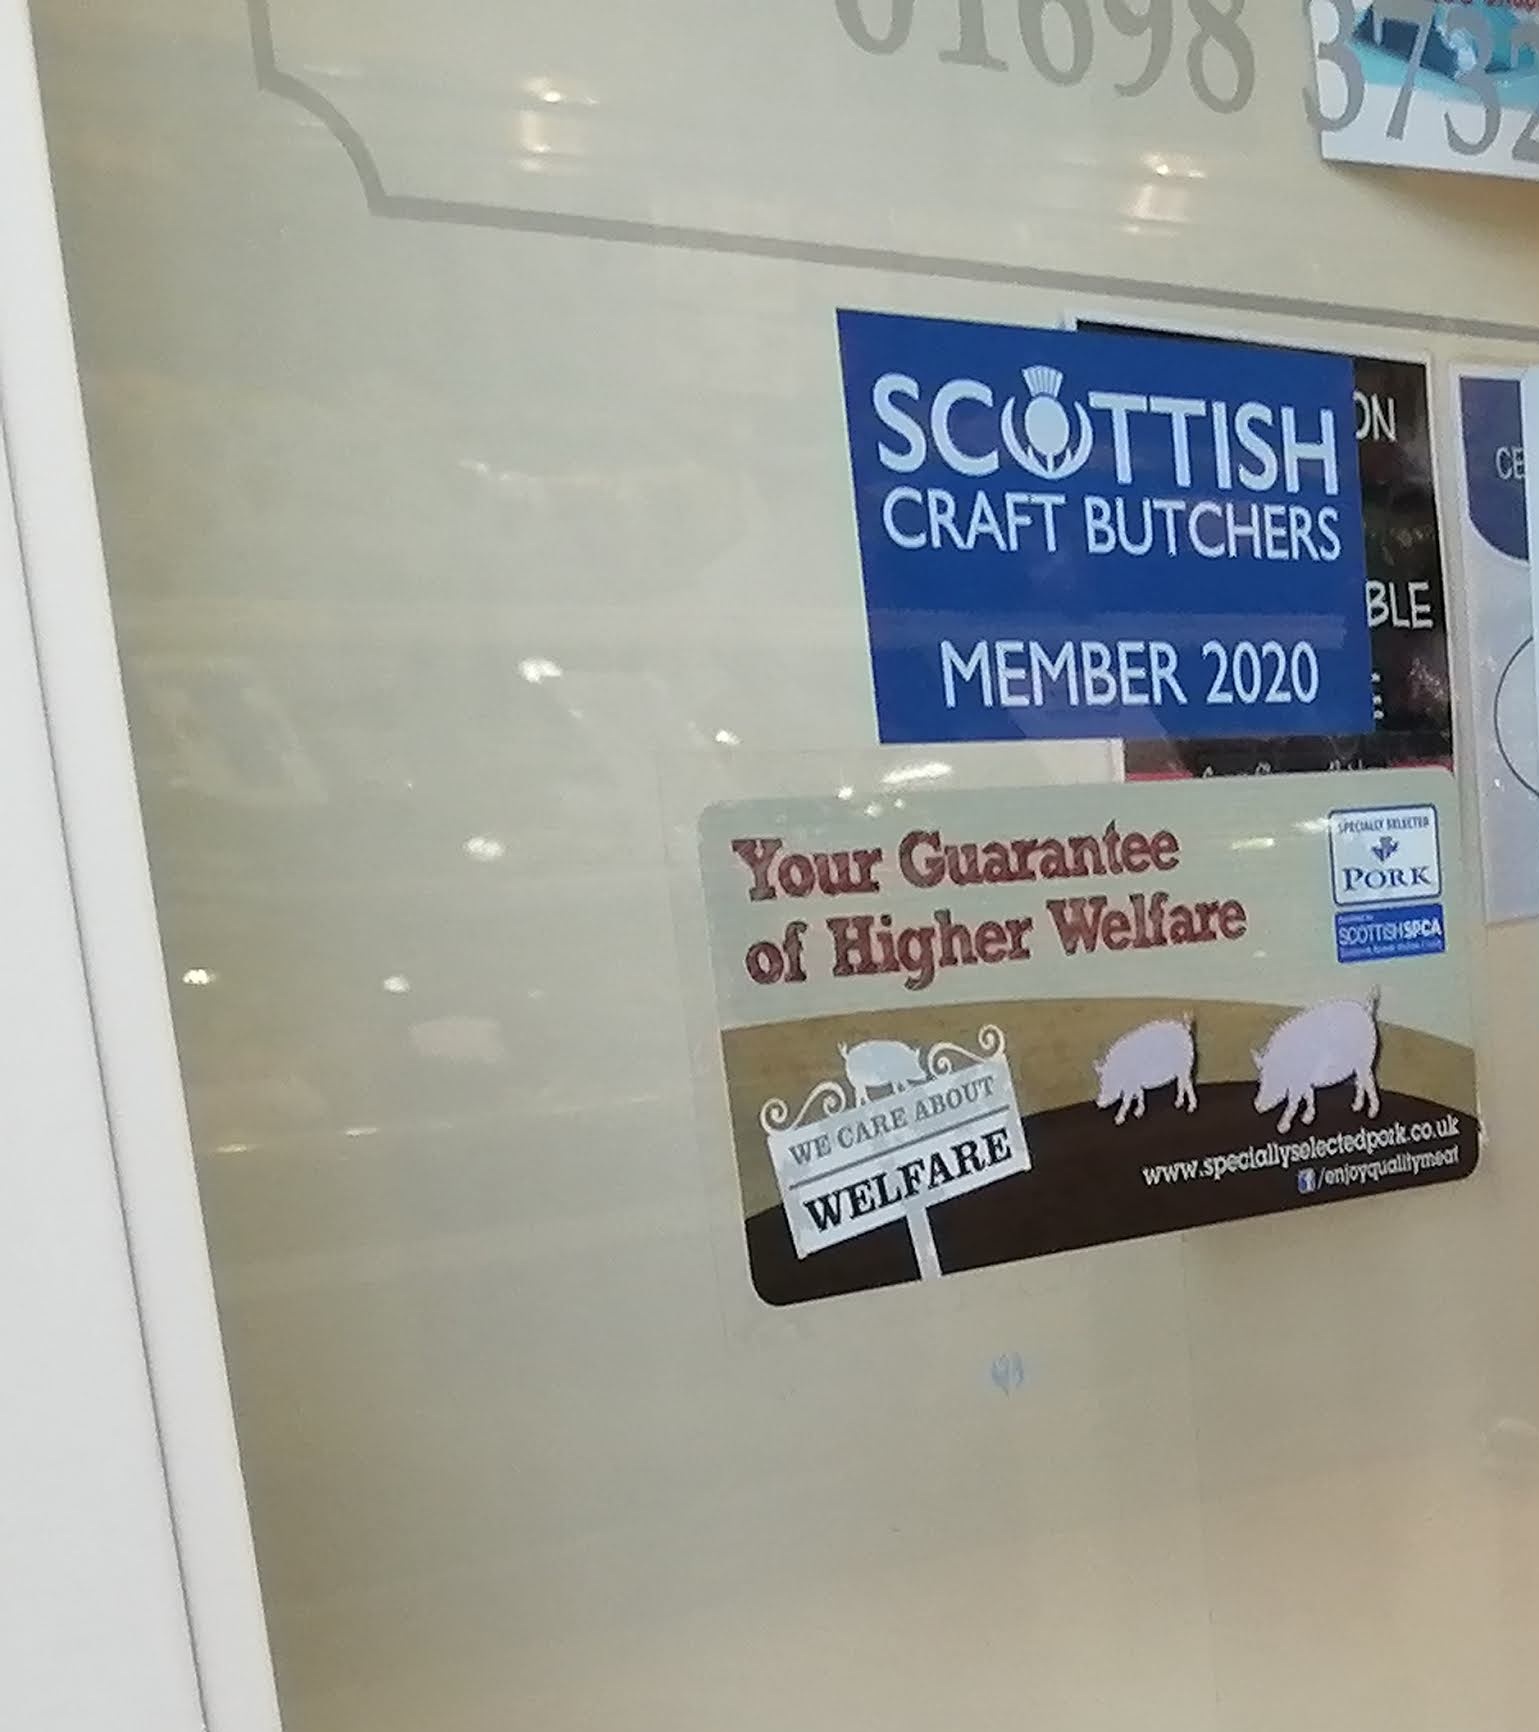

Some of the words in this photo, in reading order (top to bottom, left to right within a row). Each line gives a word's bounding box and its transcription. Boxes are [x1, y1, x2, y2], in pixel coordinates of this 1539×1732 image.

[872, 366, 1339, 495] SCOTTISH
[882, 487, 1066, 552] CRAFT
[1085, 496, 1342, 562] BUTCHERS
[1365, 579, 1434, 630] BLE
[940, 640, 1188, 708] MEMBER
[1200, 641, 1320, 704] 2020
[732, 838, 881, 901] Your
[898, 820, 1180, 888] Guarantee
[1342, 865, 1431, 891] PORK
[744, 921, 806, 985] of
[827, 912, 1033, 990] Higher
[1047, 893, 1247, 957] Welfare
[787, 1133, 834, 1168] WE
[836, 1107, 909, 1152] CARE
[914, 1075, 998, 1127] ABOUT
[1142, 1114, 1460, 1187] www.speciallyselectedpork.co.uk
[804, 1127, 1014, 1233] WELFARE
